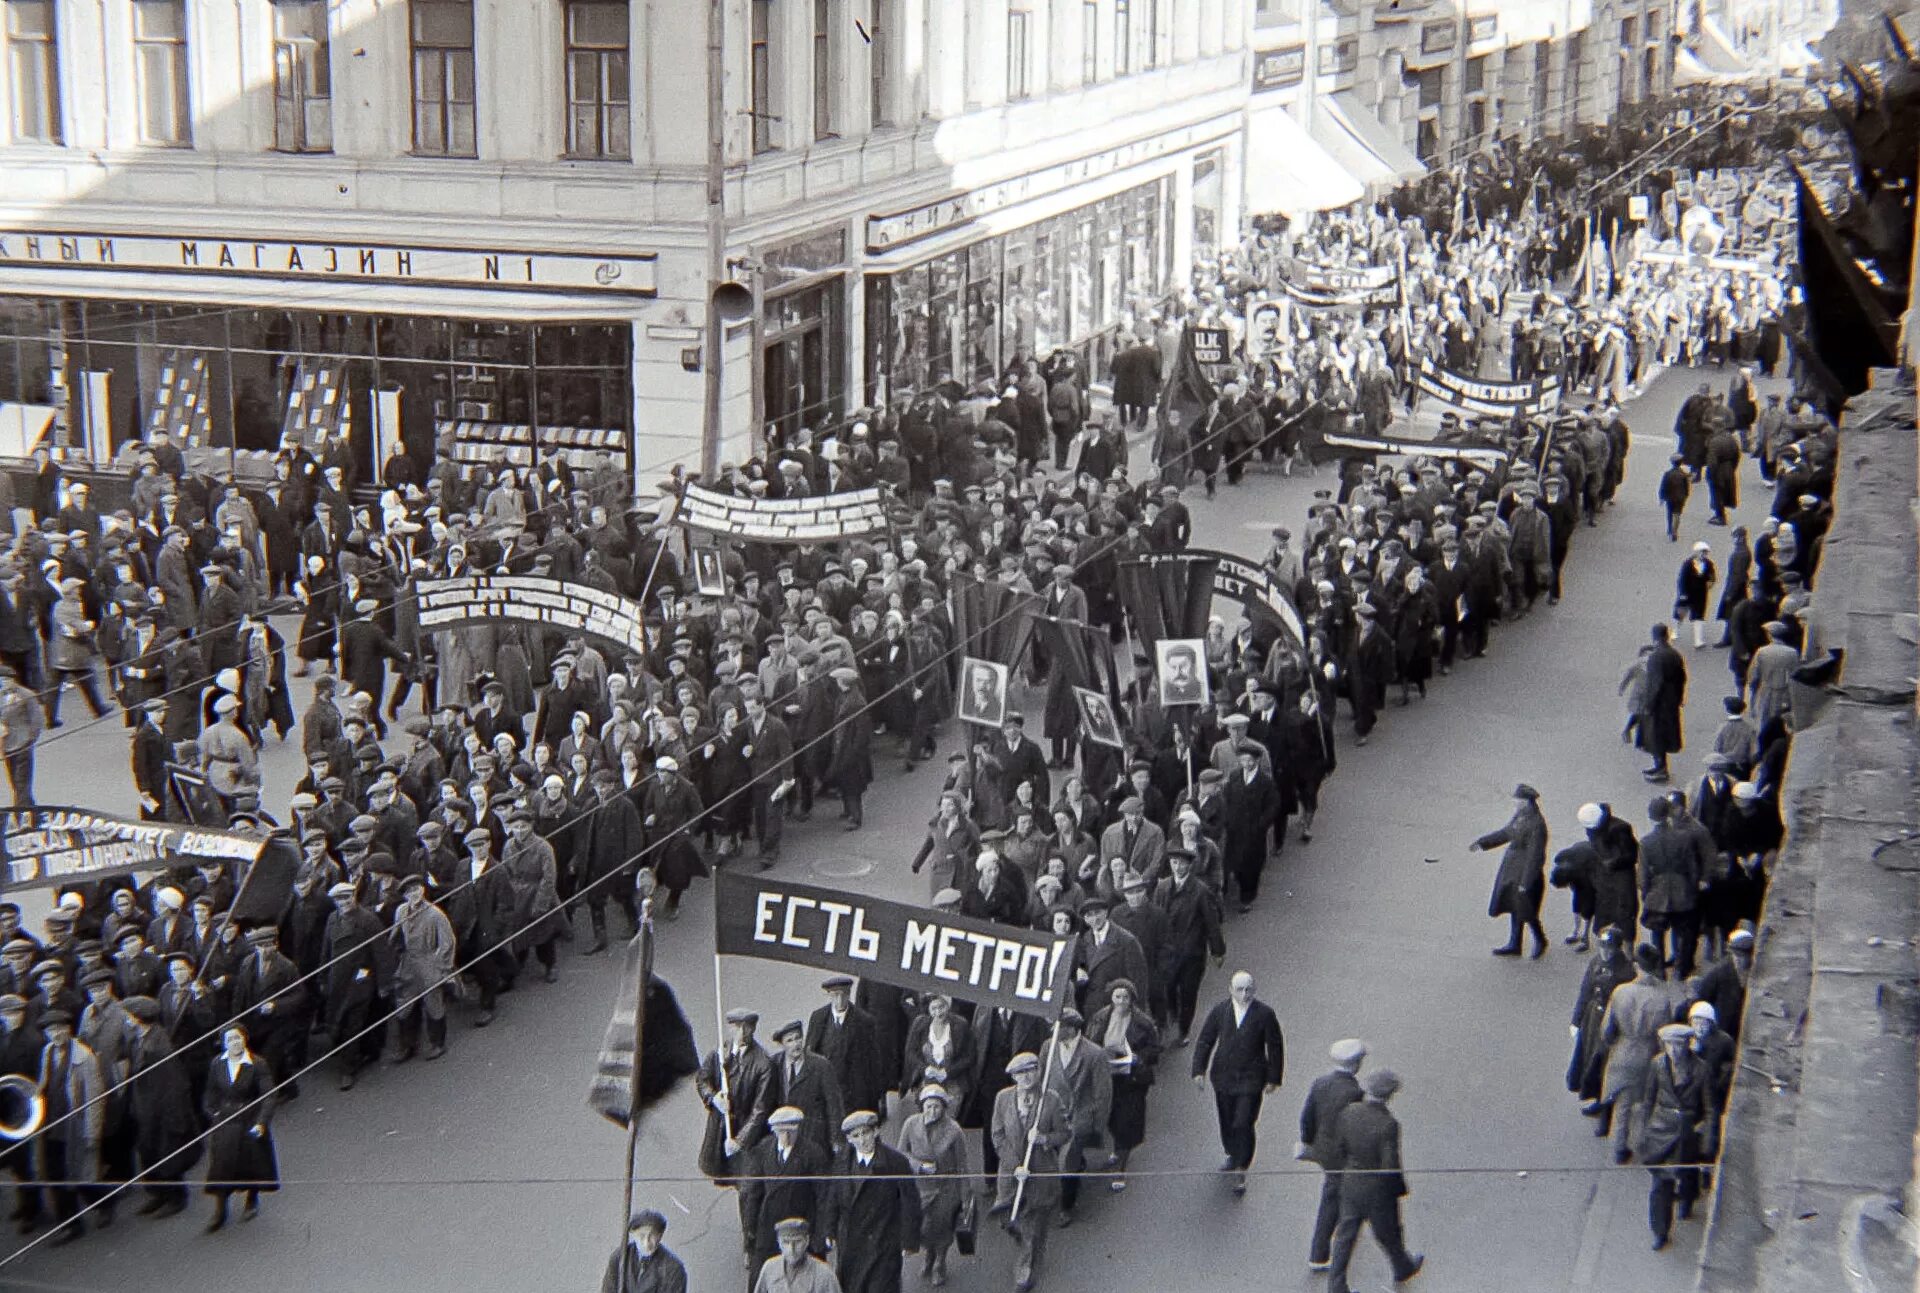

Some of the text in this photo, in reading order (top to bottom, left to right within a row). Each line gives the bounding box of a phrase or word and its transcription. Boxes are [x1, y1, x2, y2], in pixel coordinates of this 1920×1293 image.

[181, 240, 412, 276] МАГАЗИН
[754, 891, 1067, 1001] ЕСТЬ МЕТРО!
